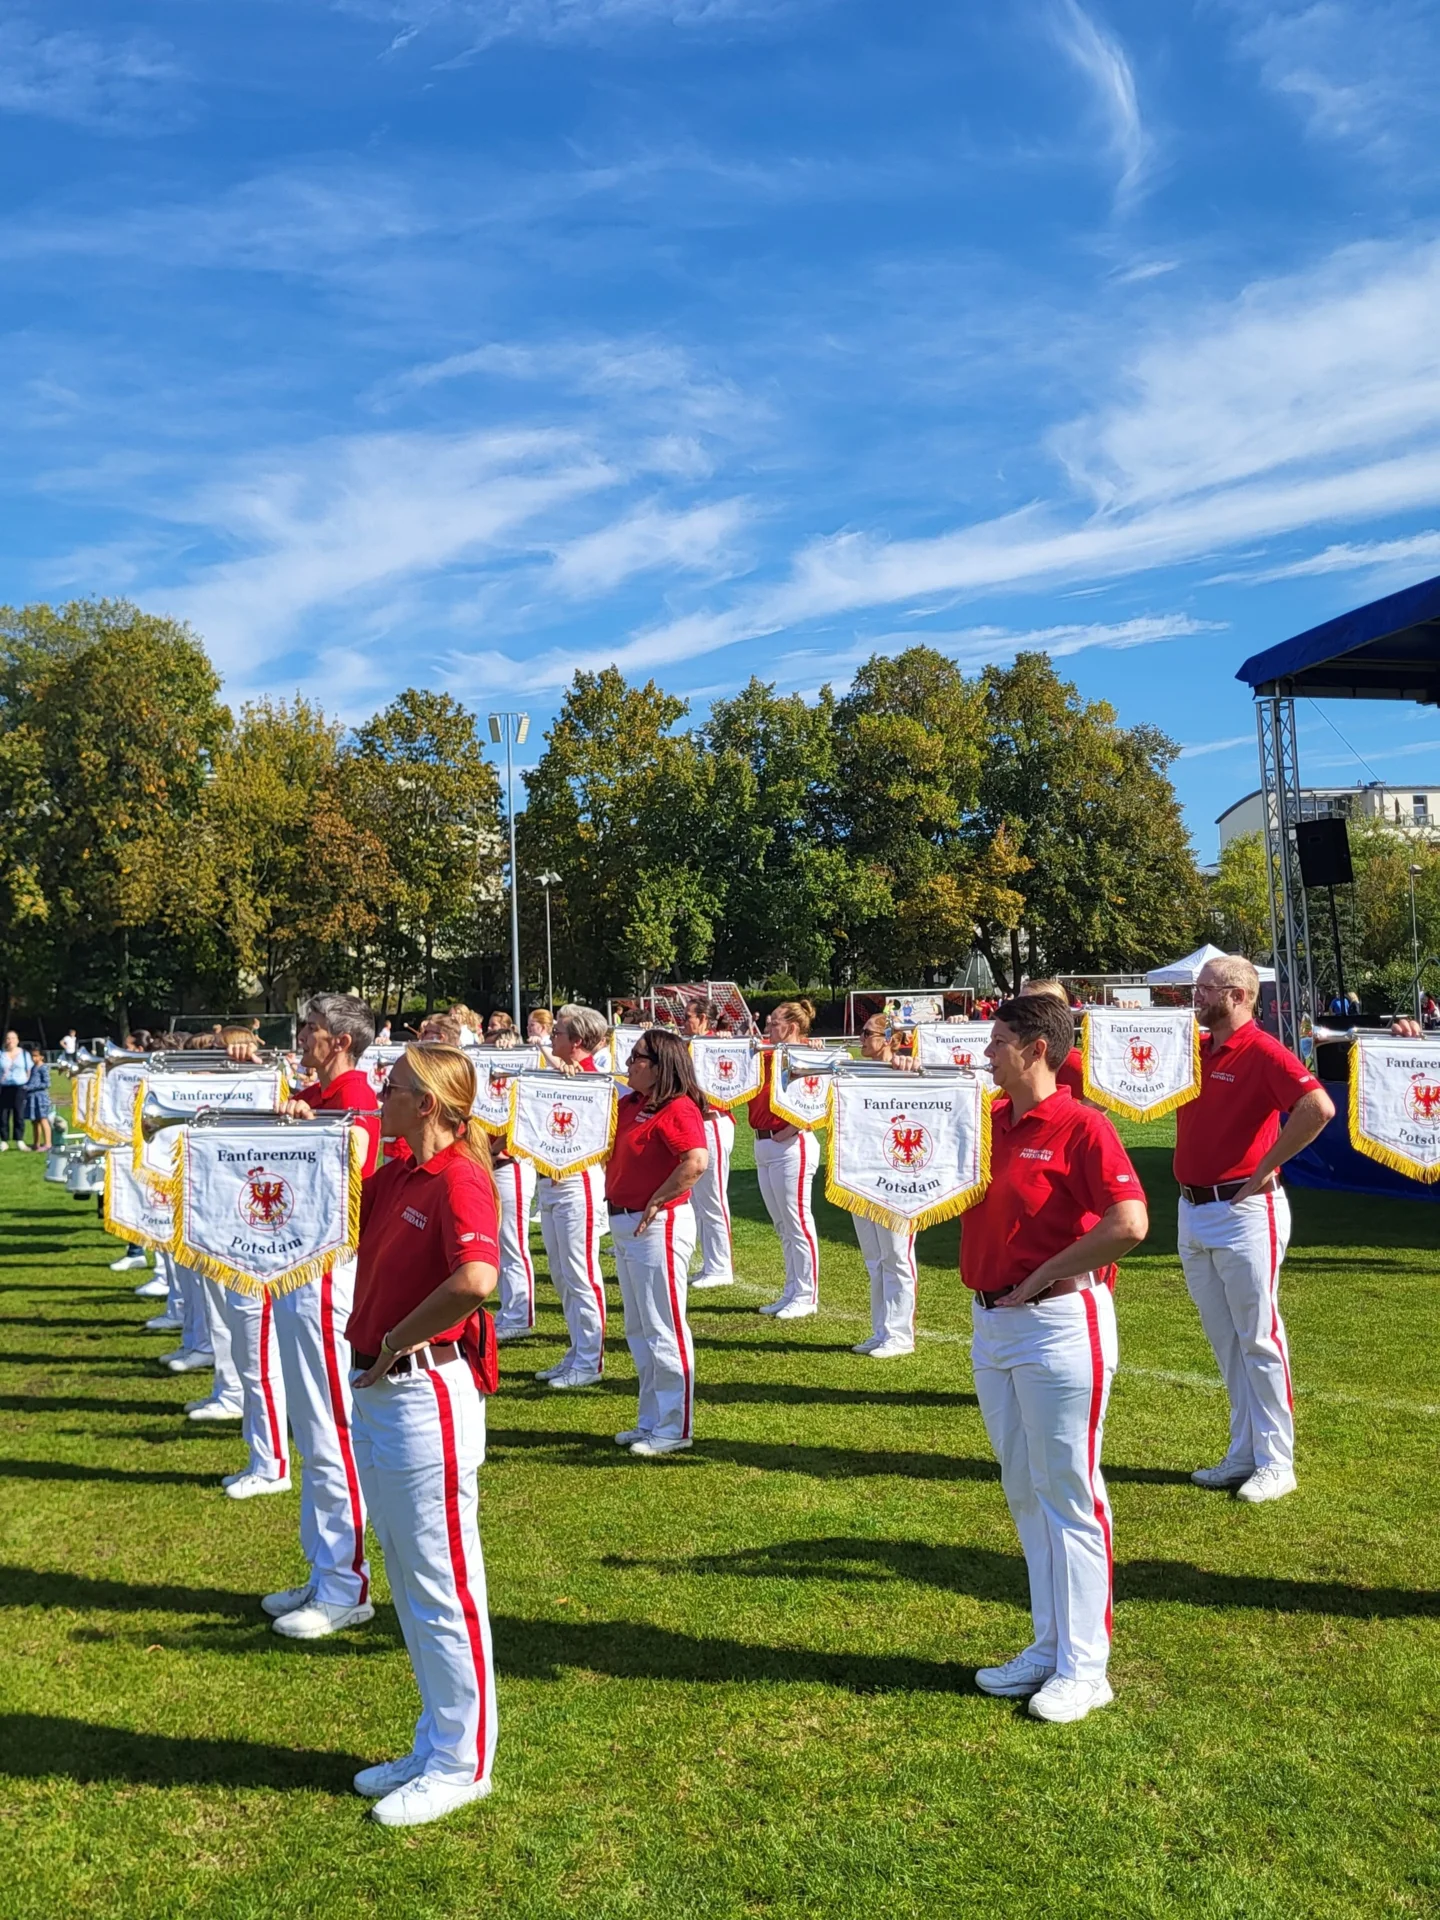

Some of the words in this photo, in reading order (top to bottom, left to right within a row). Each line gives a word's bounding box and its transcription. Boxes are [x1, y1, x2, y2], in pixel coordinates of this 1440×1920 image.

[1110, 1024, 1173, 1034] Fanfarenzug
[936, 1036, 988, 1044] Fanfarenzug
[1386, 1057, 1440, 1069] Fanfare
[117, 1073, 143, 1082] Fanfa
[711, 1082, 742, 1091] Potsdam
[1119, 1080, 1165, 1093] Potsdam
[171, 1089, 254, 1102] Fanfarenzug
[535, 1090, 594, 1103] Fanfarenzug
[480, 1103, 509, 1114] Potsda
[863, 1098, 952, 1112] Fanfarenzug
[539, 1141, 582, 1154] Potsdam
[217, 1148, 317, 1163] Fanfarenzug
[875, 1176, 941, 1194] Potsdam
[141, 1213, 171, 1225] Potsd
[231, 1236, 303, 1255] Potsdam
